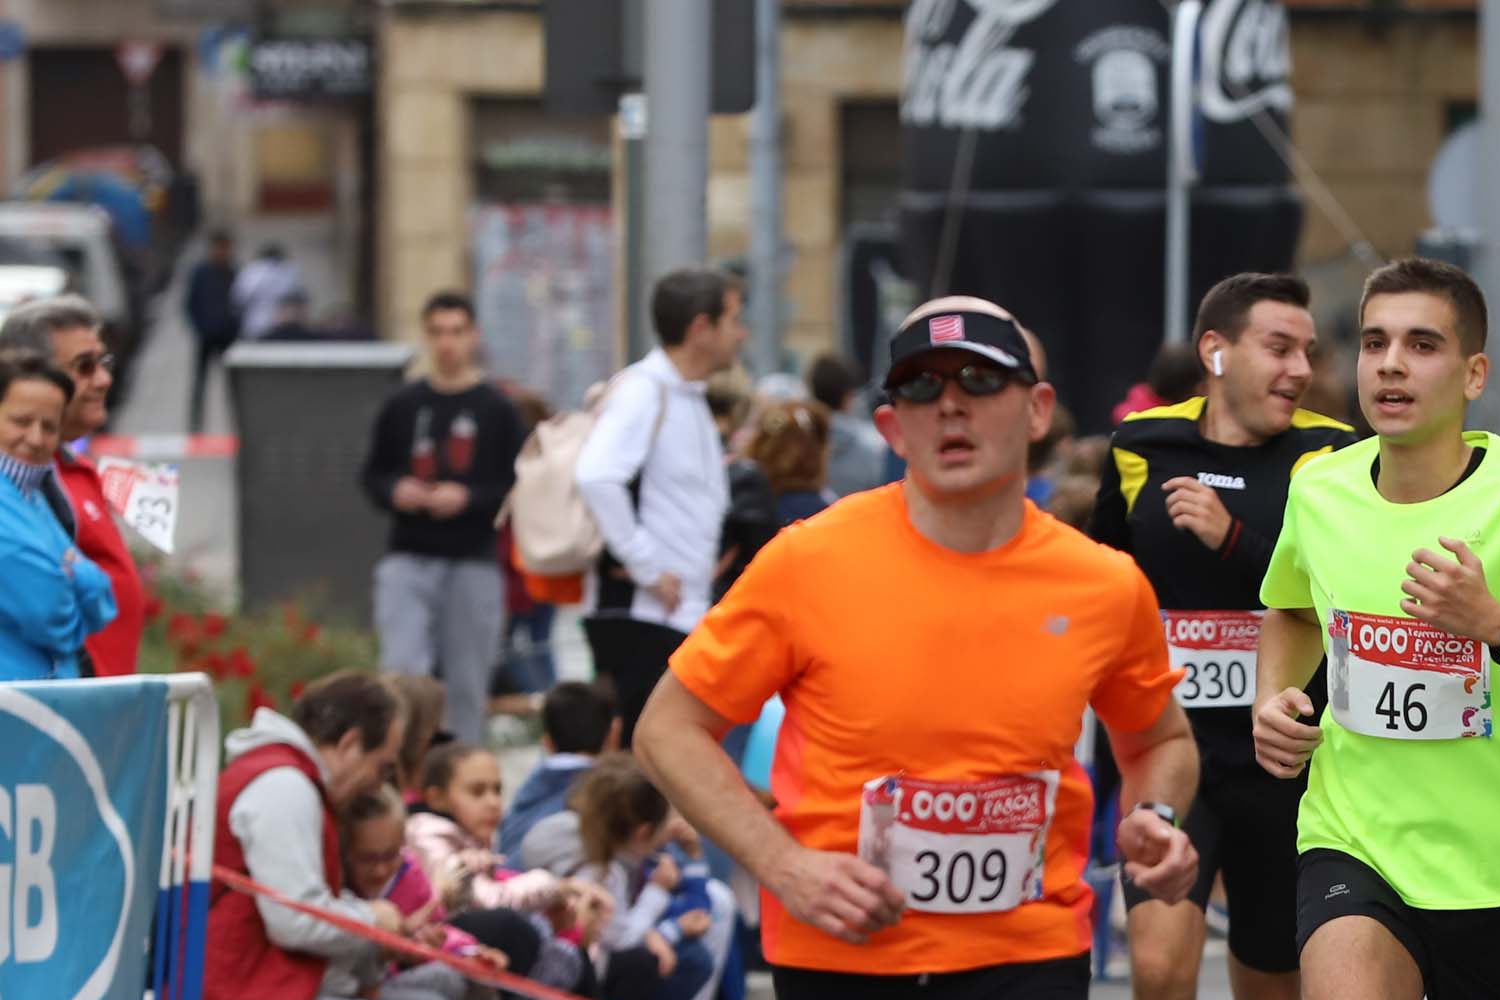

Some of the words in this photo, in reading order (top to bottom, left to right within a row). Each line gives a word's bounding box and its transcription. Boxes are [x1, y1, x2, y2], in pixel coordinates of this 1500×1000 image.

[1165, 618, 1216, 642] 1.000
[1346, 622, 1408, 655] 1.000
[1414, 638, 1474, 656] PASOS
[1182, 660, 1246, 700] 330
[1375, 682, 1428, 732] 46
[893, 787, 977, 822] 1.000
[911, 849, 1007, 904] 309
